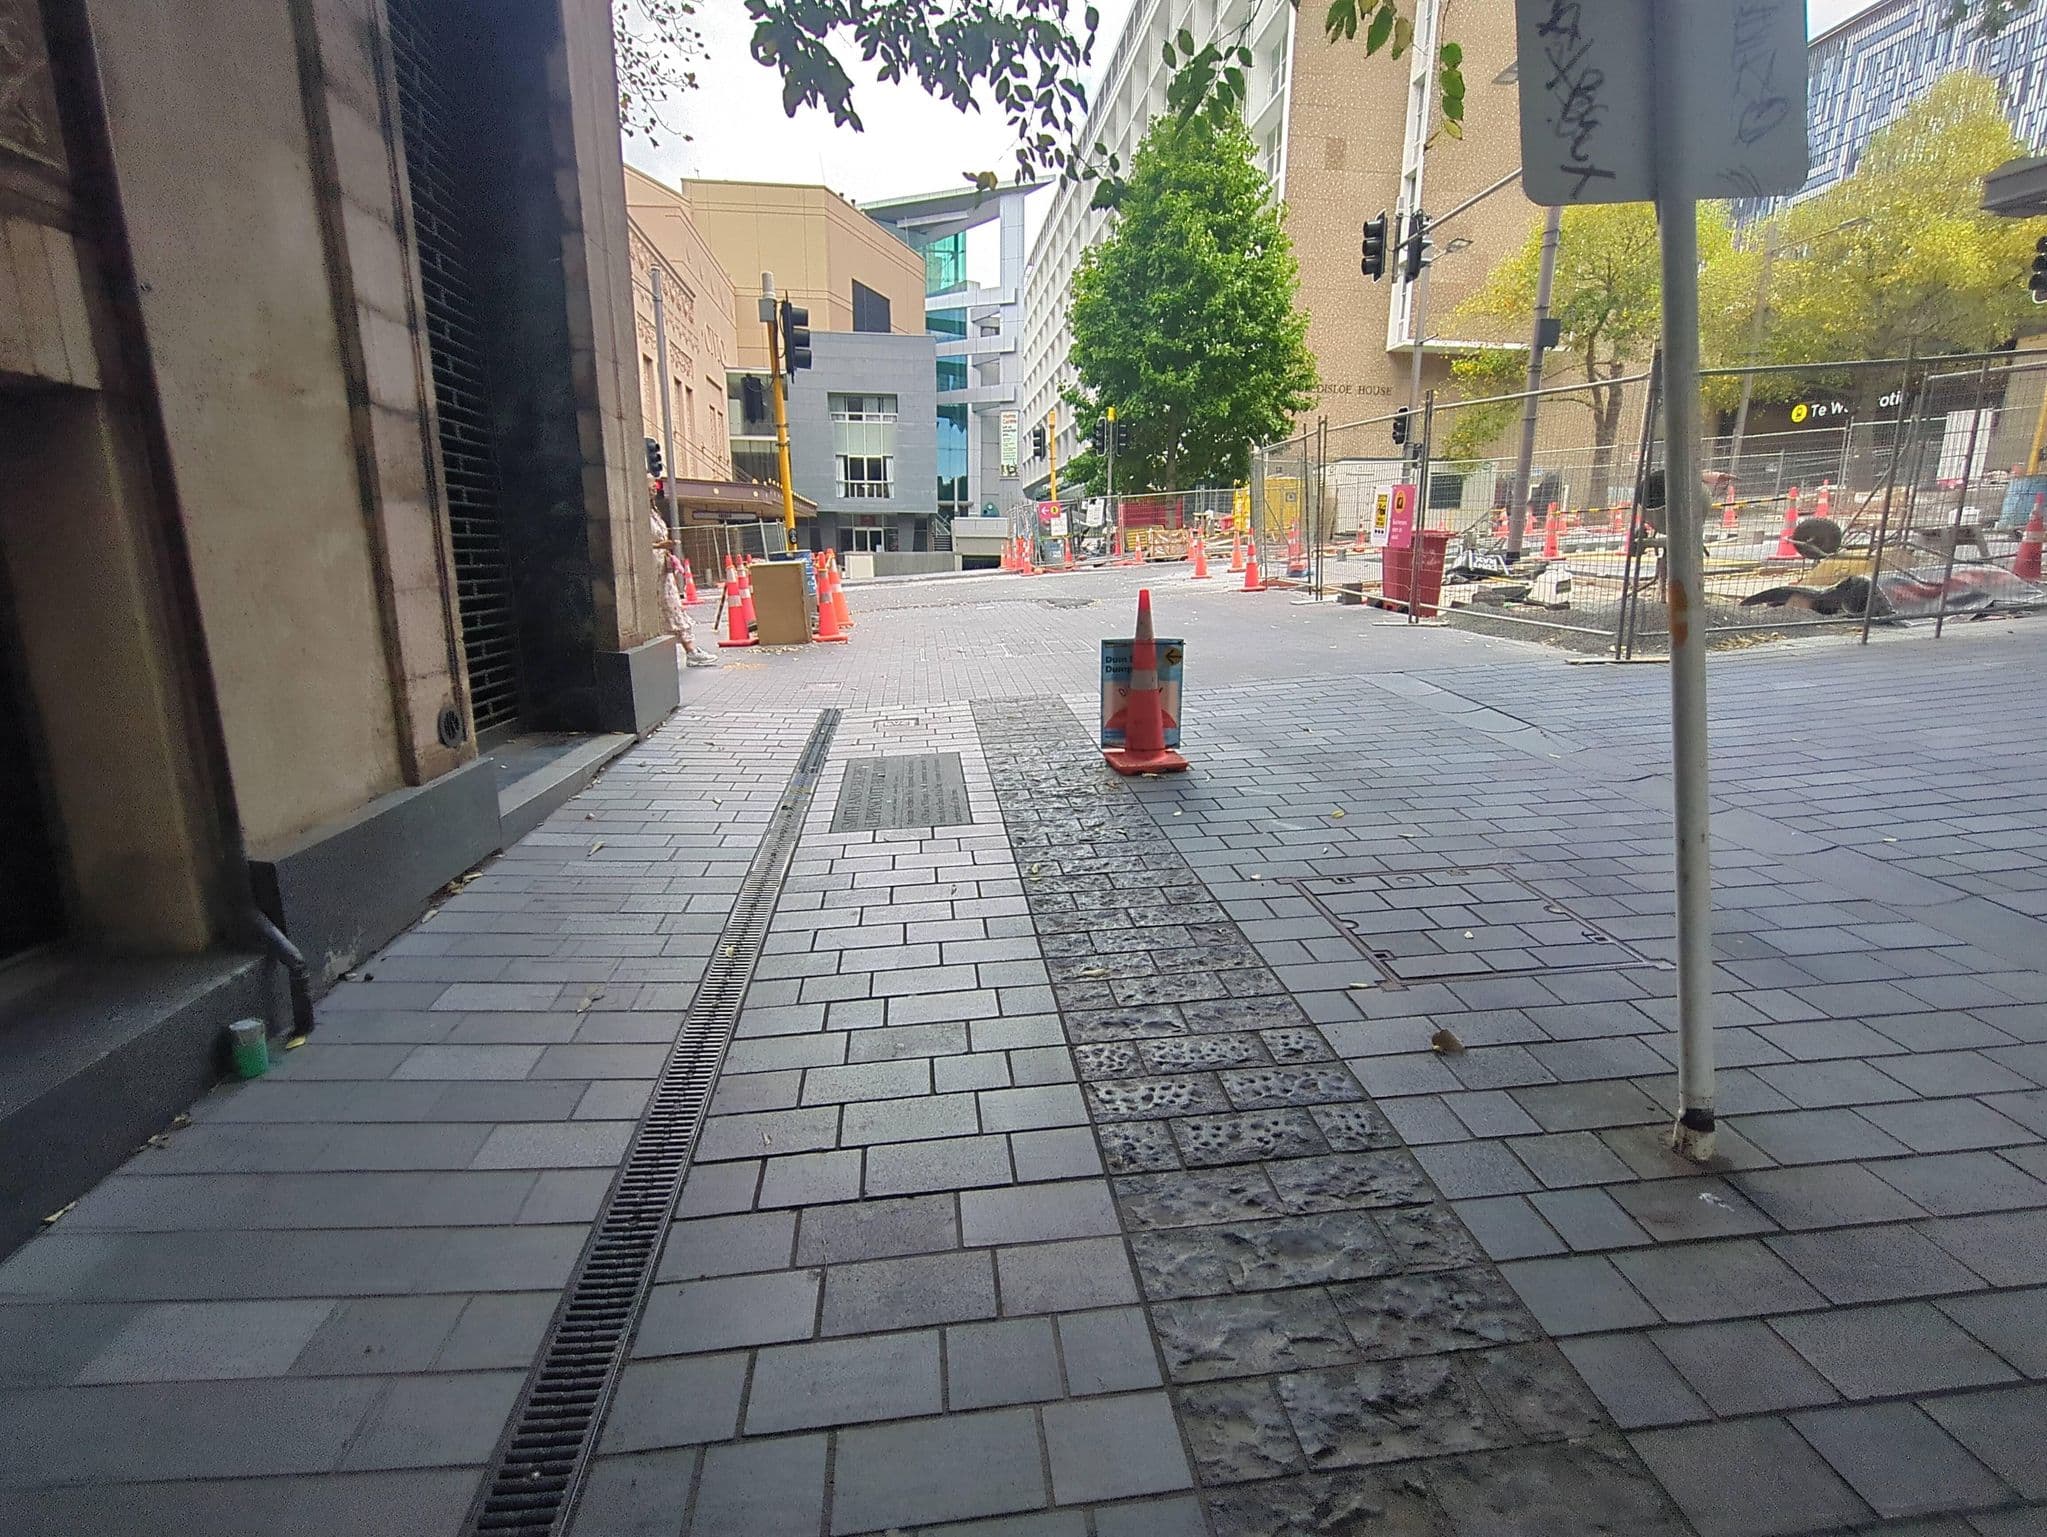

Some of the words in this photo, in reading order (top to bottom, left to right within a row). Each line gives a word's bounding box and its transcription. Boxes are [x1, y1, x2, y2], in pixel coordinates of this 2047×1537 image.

[1312, 383, 1352, 395] DISLOE
[1358, 384, 1393, 396] HOUSE
[1811, 403, 1827, 417] Te
